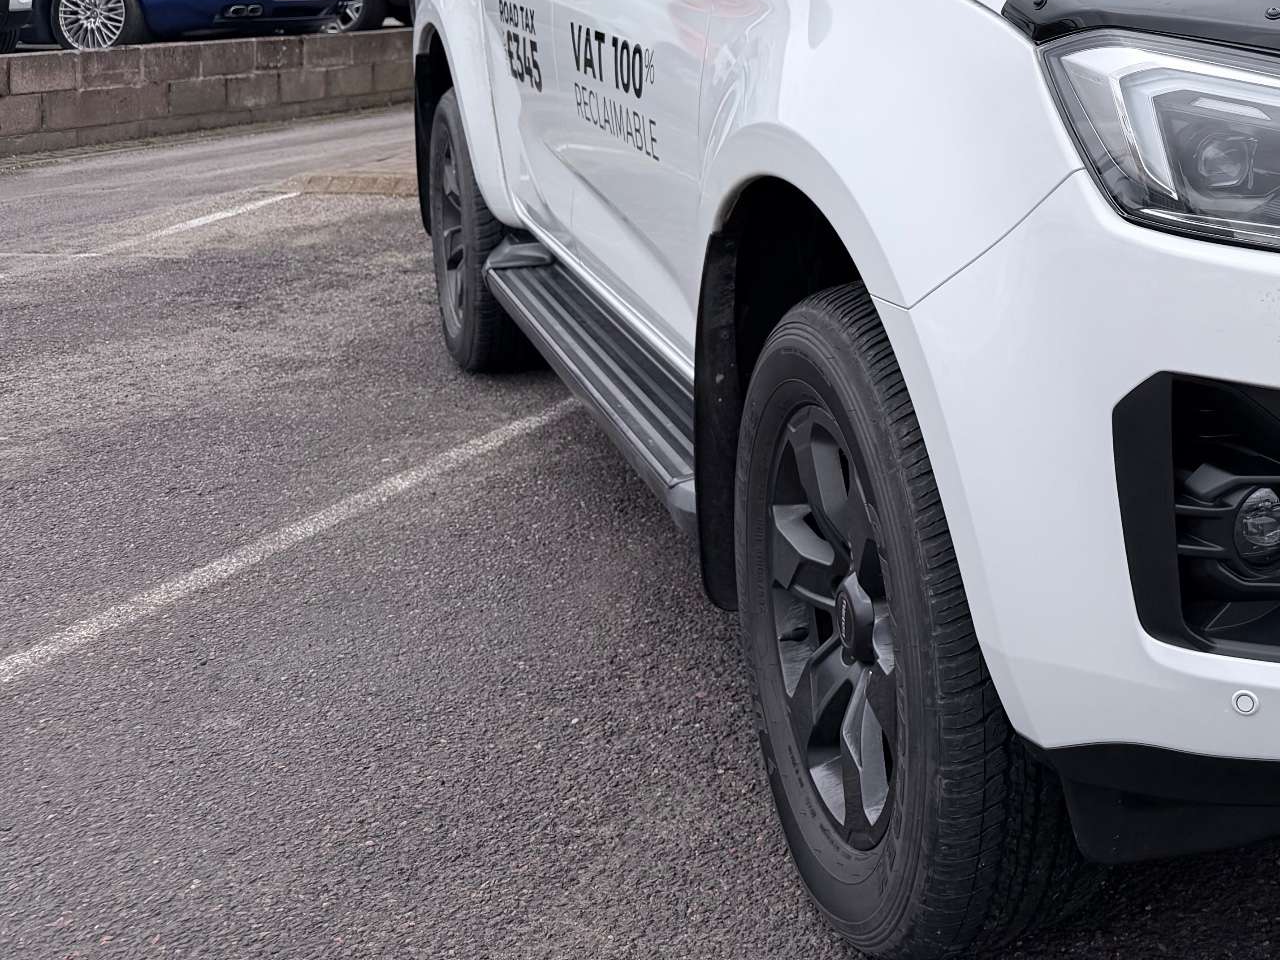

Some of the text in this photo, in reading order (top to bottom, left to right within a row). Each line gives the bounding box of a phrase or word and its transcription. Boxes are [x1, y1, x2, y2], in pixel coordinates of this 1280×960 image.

[498, 0, 536, 36] ROAD TAX
[507, 30, 543, 93] £345
[570, 21, 656, 99] VAT 100%
[574, 82, 660, 162] RECLAIMABLE
